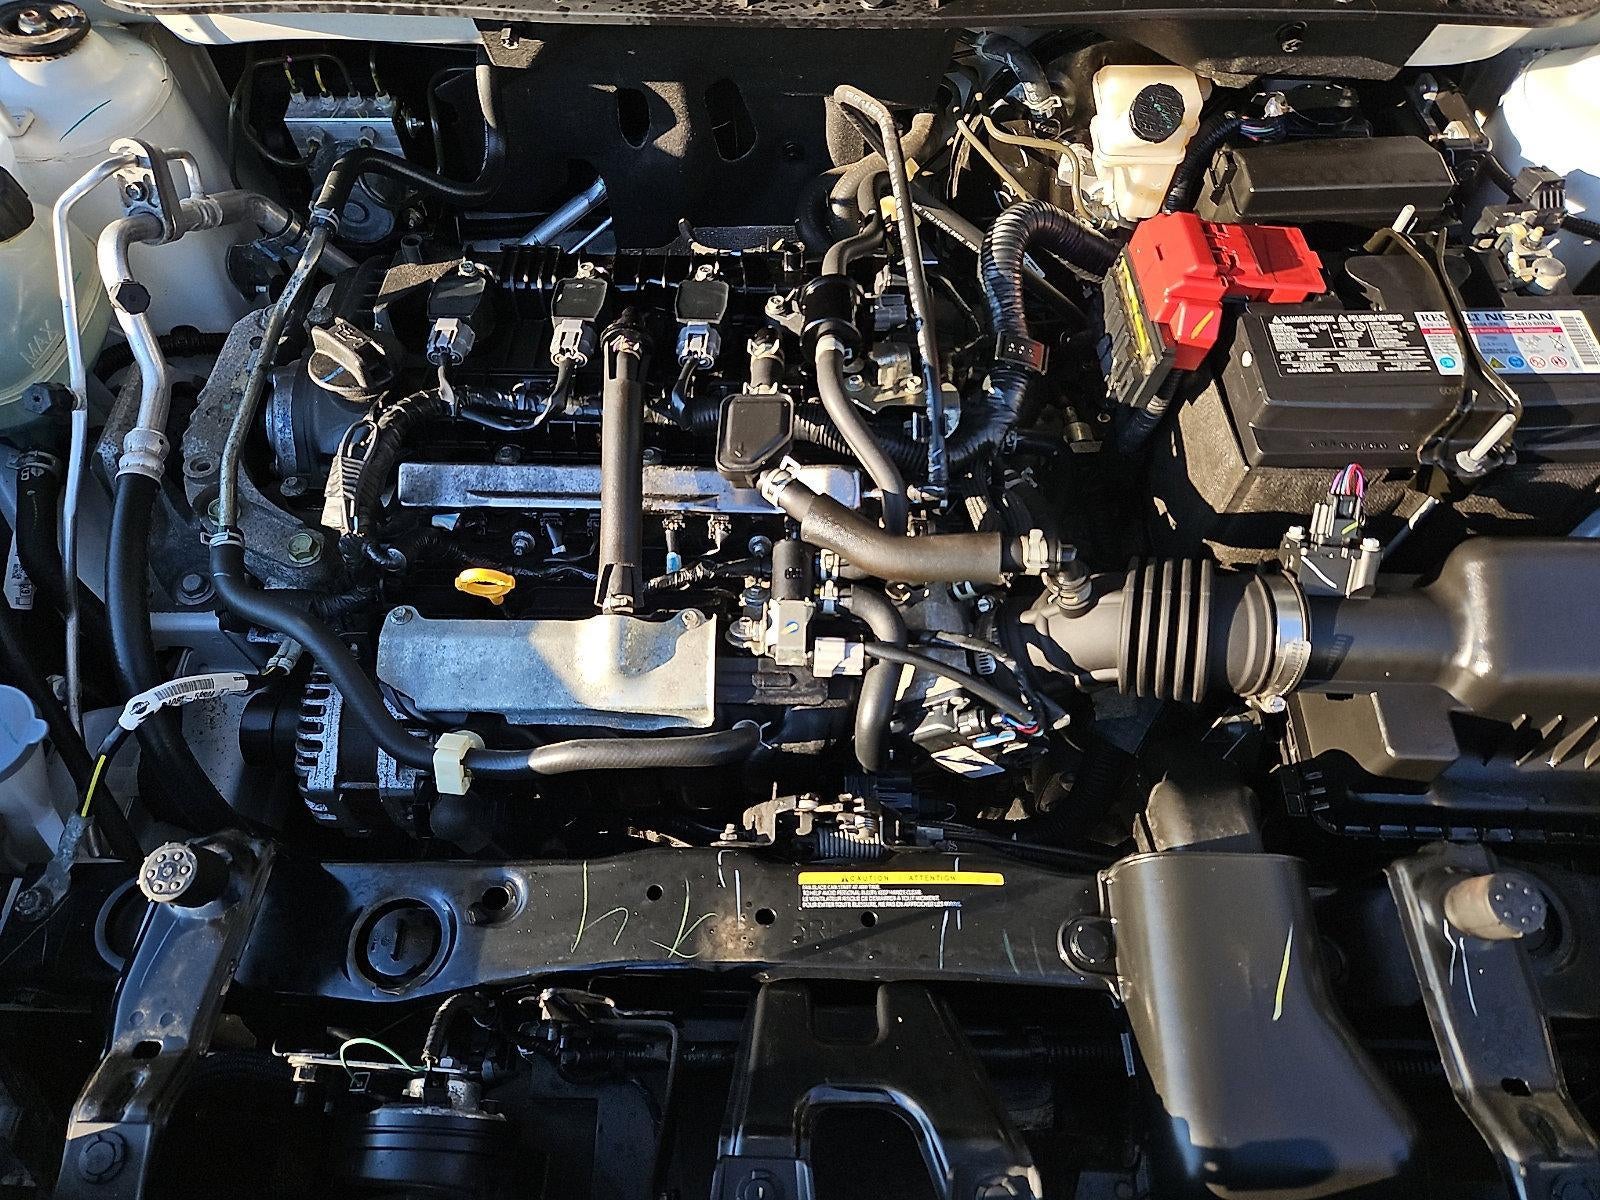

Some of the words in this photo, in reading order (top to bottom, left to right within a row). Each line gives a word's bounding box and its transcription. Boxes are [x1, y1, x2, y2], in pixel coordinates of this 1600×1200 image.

[1485, 312, 1554, 321] NISSAN
[19, 319, 58, 366] MAX
[908, 874, 956, 882] ATTENTION
